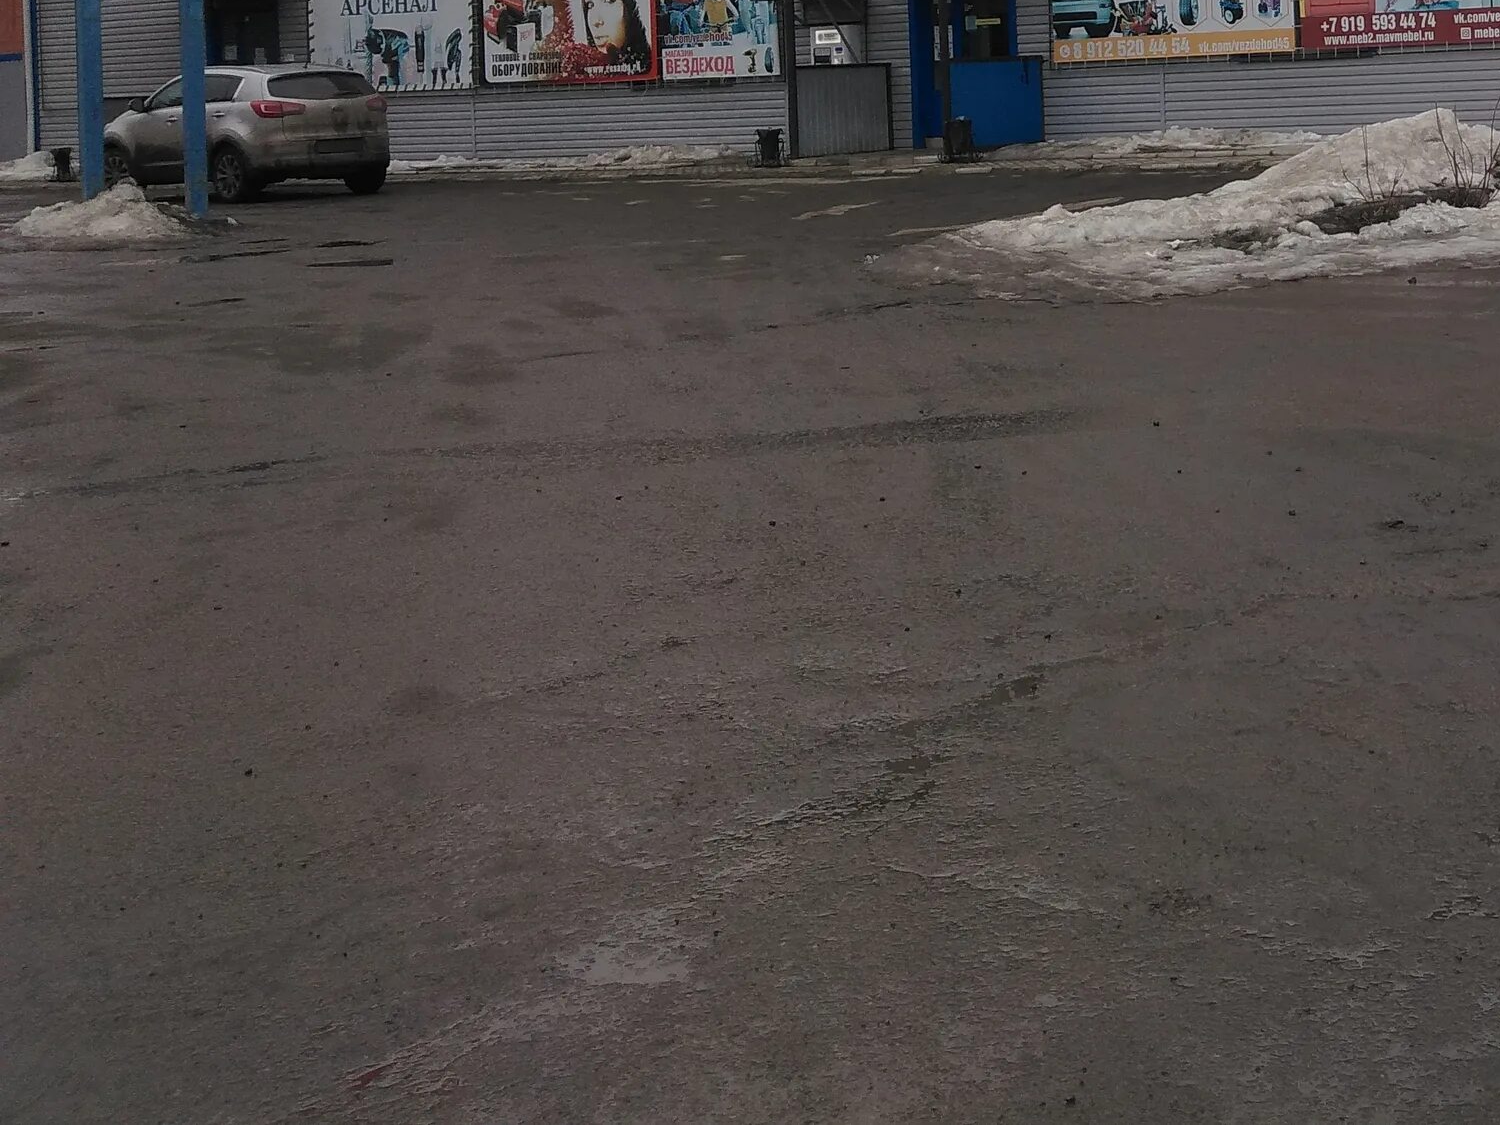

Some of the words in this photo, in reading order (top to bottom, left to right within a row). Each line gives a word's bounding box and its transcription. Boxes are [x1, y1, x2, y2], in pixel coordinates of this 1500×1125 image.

[1321, 17, 1337, 32] +7
[1341, 16, 1365, 32] 919
[1372, 14, 1396, 31] 593
[1400, 13, 1417, 29] 44
[1419, 12, 1436, 28] 74
[1324, 30, 1434, 45] www.meb2.mavmebel.ru
[1073, 42, 1082, 59] 8
[1087, 41, 1113, 58] 912
[1117, 38, 1144, 56] 520
[1149, 38, 1167, 55] 44
[1171, 36, 1190, 54] 54
[491, 62, 563, 77] ОБОРУДОВАНИЕ
[666, 56, 735, 75] ВЕЗДЕХОД
